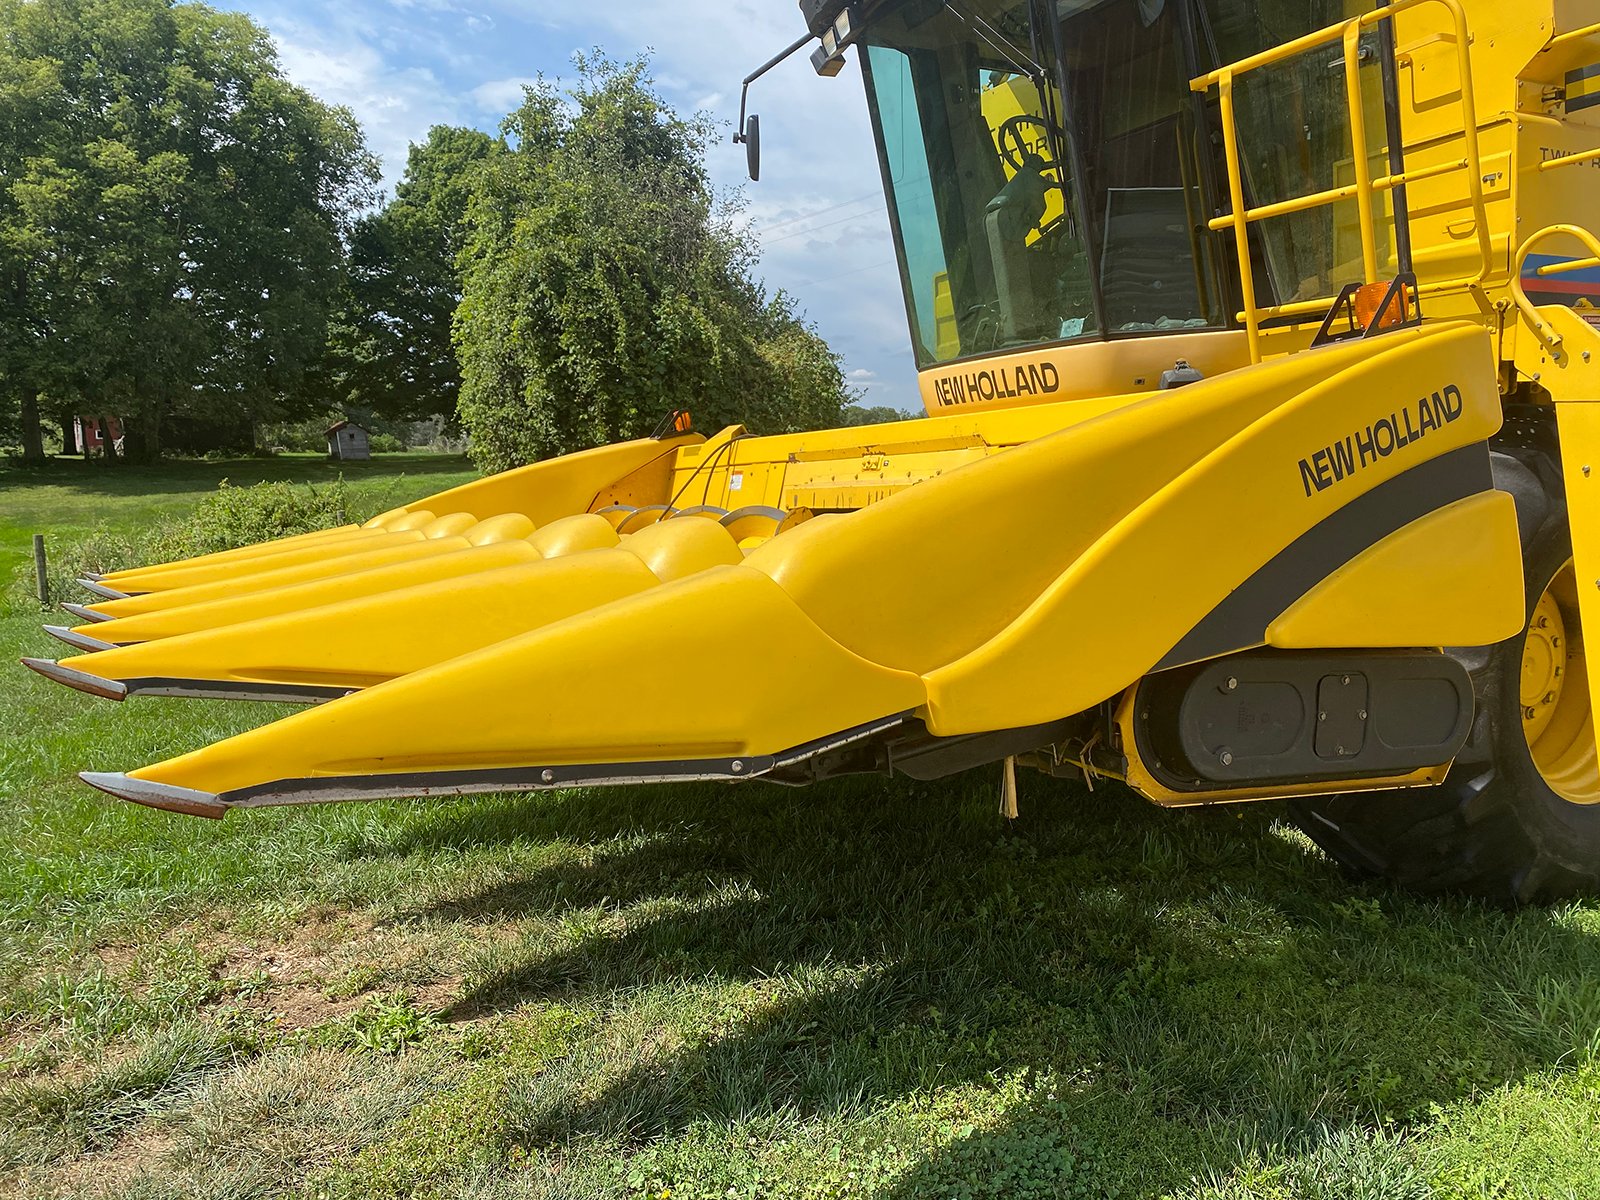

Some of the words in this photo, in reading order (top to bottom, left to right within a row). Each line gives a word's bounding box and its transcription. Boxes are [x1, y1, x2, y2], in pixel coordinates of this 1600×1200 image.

[934, 375, 967, 407] NEW
[965, 362, 1060, 402] HOLLAND
[1298, 436, 1355, 497] NEW
[1354, 384, 1462, 468] HOLLAND
